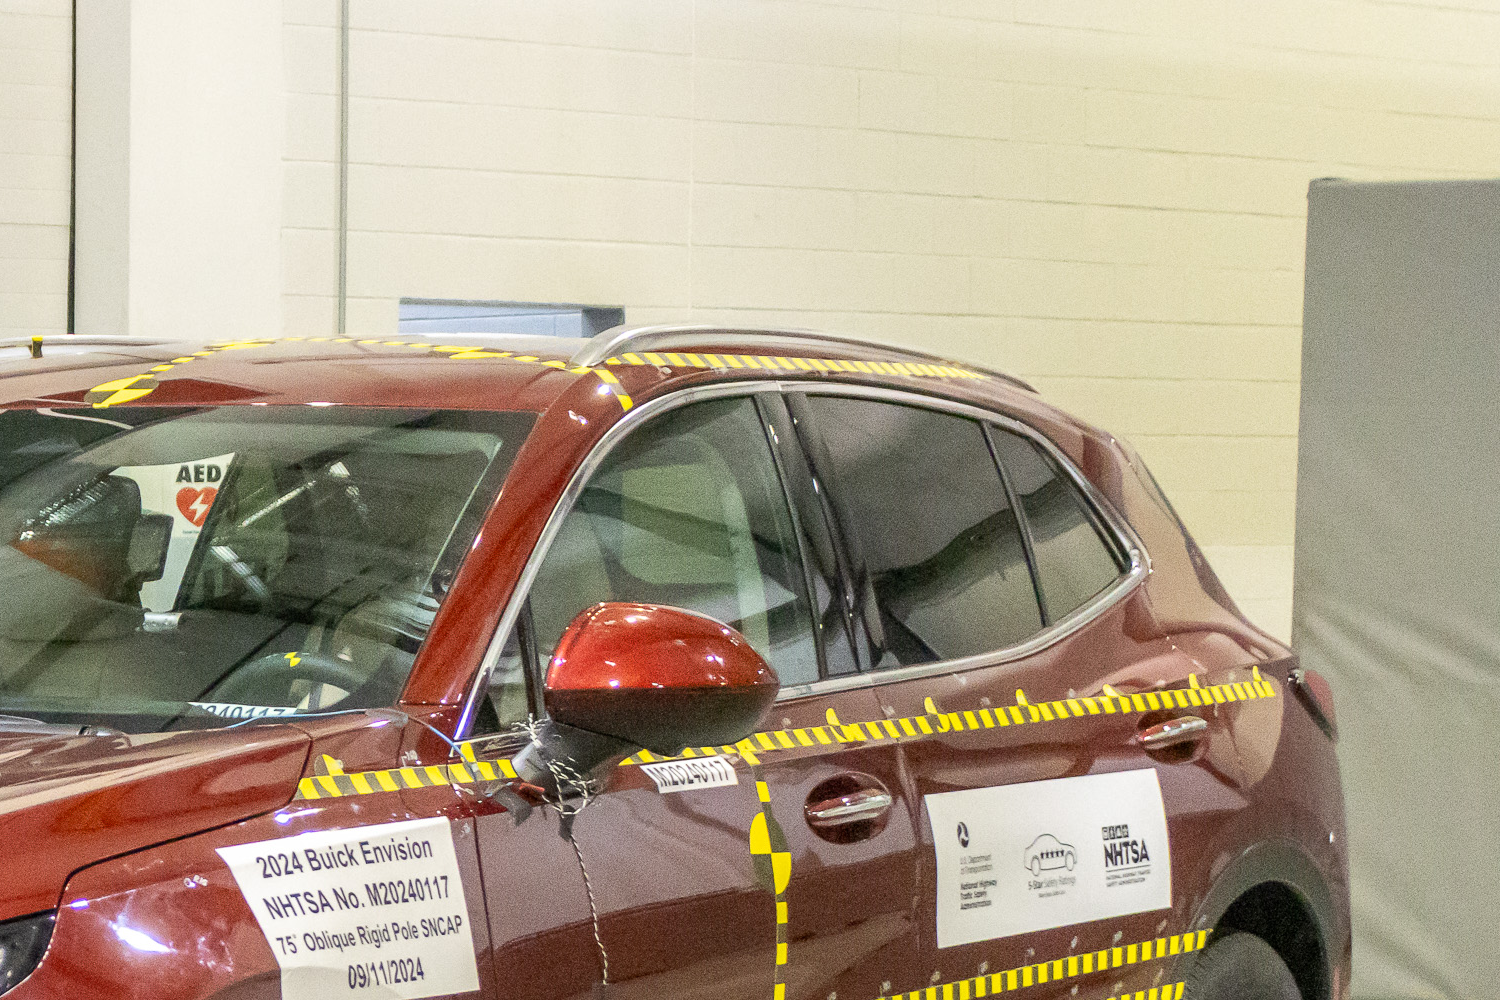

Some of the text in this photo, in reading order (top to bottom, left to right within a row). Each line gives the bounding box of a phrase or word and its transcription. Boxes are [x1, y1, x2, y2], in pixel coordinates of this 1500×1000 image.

[176, 464, 222, 483] AED
[647, 760, 729, 787] M20240117
[256, 836, 433, 878] 2024 Buick Envision
[1103, 839, 1150, 868] NHTSA
[263, 875, 449, 919] NHTSA No. M20240117
[303, 930, 357, 952] Oblique
[356, 923, 391, 948] Rigid
[391, 921, 419, 941] Pole
[420, 914, 463, 938] SNCAP
[348, 957, 425, 989] 09/11/2024
